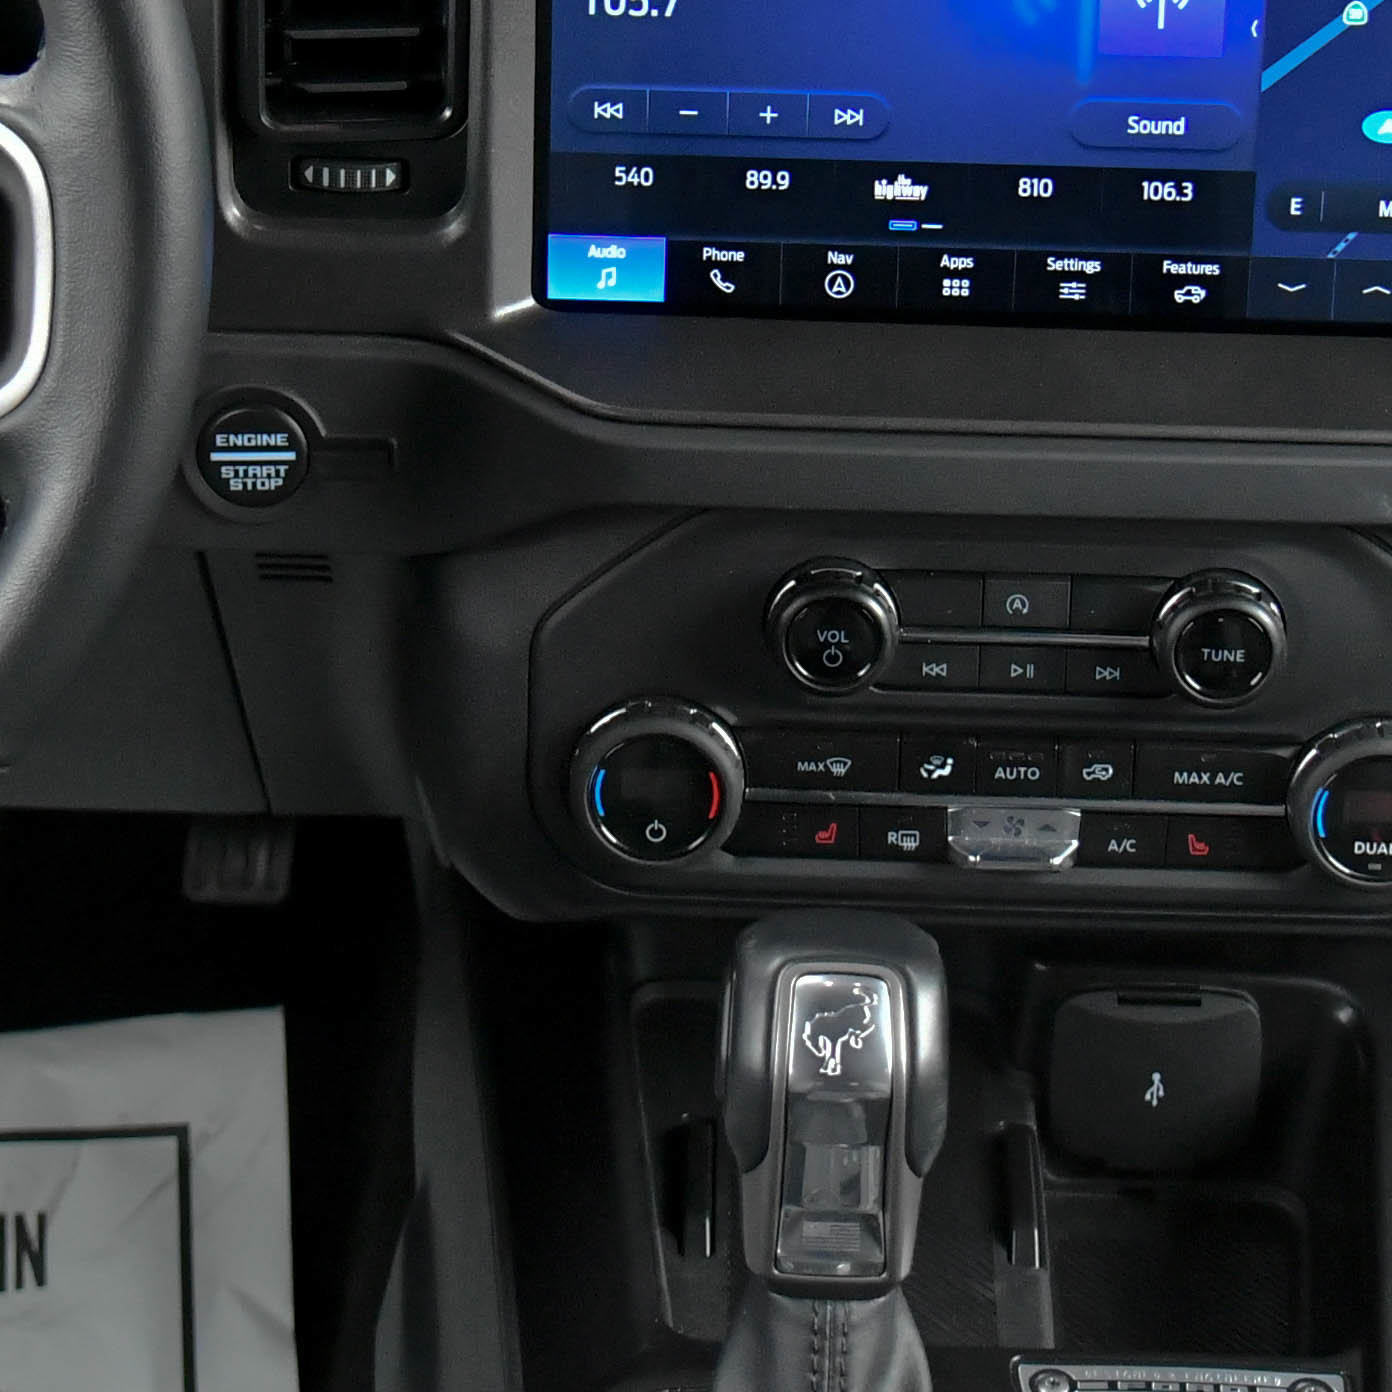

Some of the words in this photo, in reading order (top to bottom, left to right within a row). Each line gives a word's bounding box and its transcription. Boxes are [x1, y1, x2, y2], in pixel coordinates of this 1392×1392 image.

[1127, 116, 1186, 136] Sound
[614, 166, 654, 187] 540
[745, 170, 790, 191] 89.9
[1017, 177, 1054, 199] 810
[1141, 181, 1194, 202] 106.3
[1289, 198, 1302, 215] E
[587, 244, 627, 260] Audio
[702, 247, 745, 263] Phone
[827, 251, 854, 266] Nav
[939, 254, 974, 273] Apps
[1046, 257, 1102, 274] Settings
[1162, 260, 1221, 277] Features
[215, 433, 289, 447] ENGINE
[220, 465, 289, 479] START
[229, 478, 284, 491] STOP
[817, 630, 849, 645] VOL
[1200, 649, 1246, 664] TUNE
[798, 760, 825, 773] MAX
[994, 767, 1041, 781] AUTO
[1173, 771, 1211, 785] MAX
[1214, 772, 1245, 788] A/C
[888, 834, 898, 846] R
[1107, 839, 1137, 853] A/C
